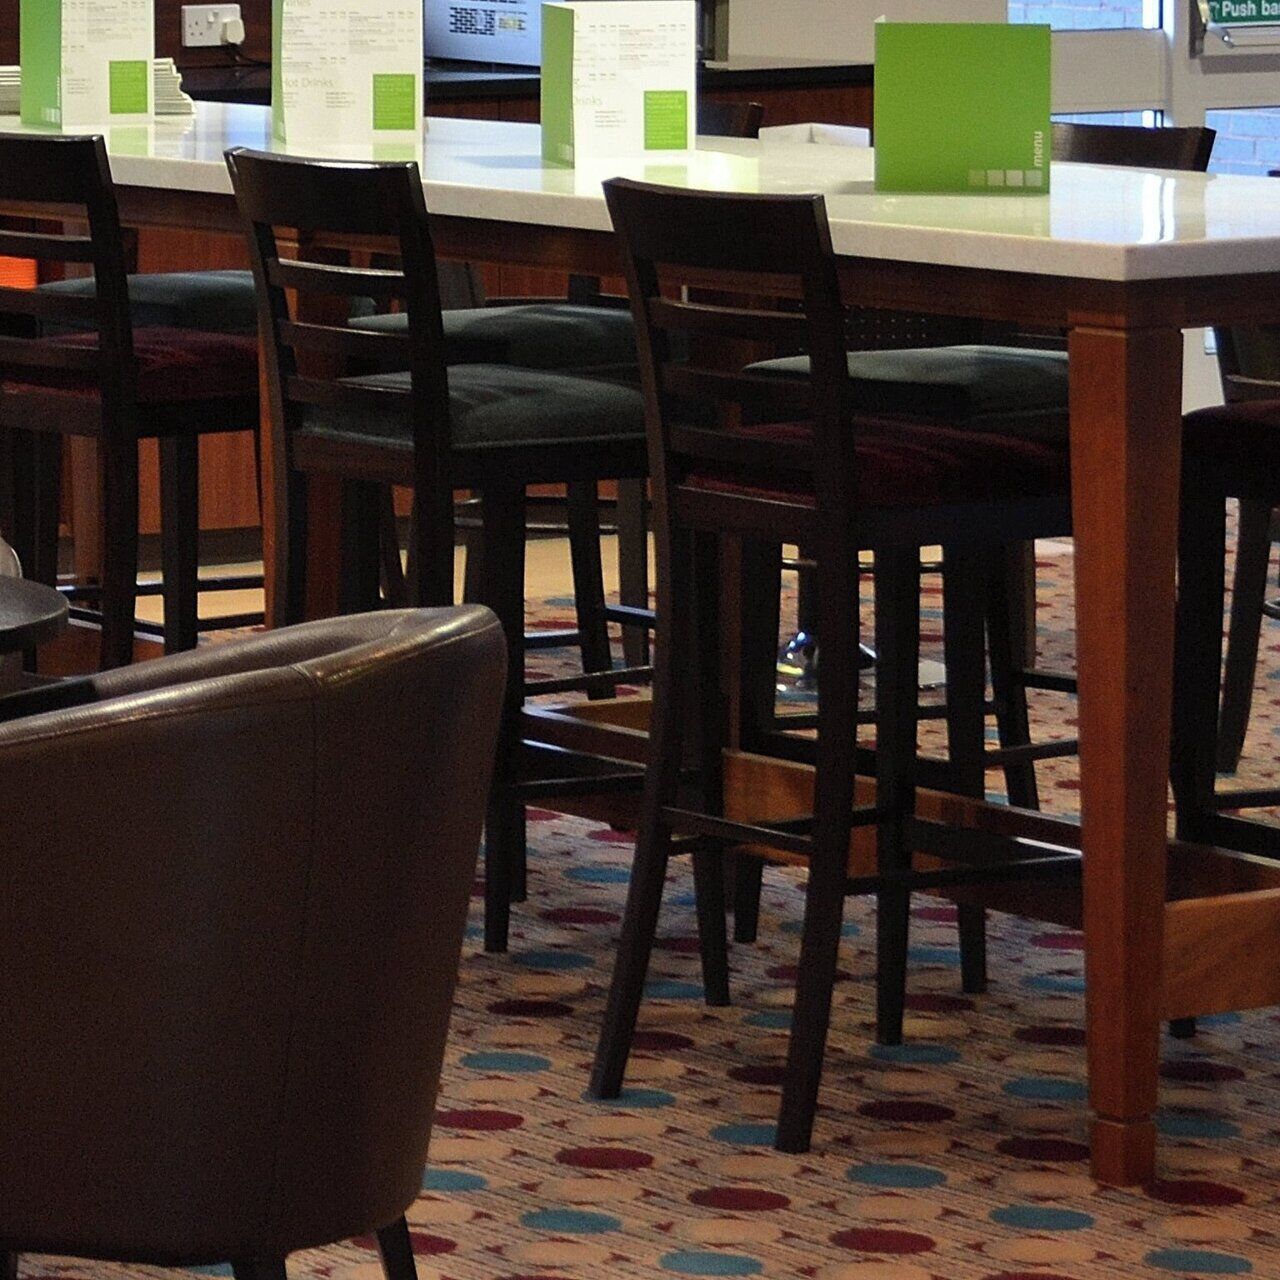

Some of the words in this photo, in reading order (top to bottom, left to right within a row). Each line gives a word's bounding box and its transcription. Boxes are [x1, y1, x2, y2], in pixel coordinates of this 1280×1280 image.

[1222, 0, 1256, 17] Push
[1261, 0, 1280, 16] ba
[1033, 131, 1043, 167] menu
